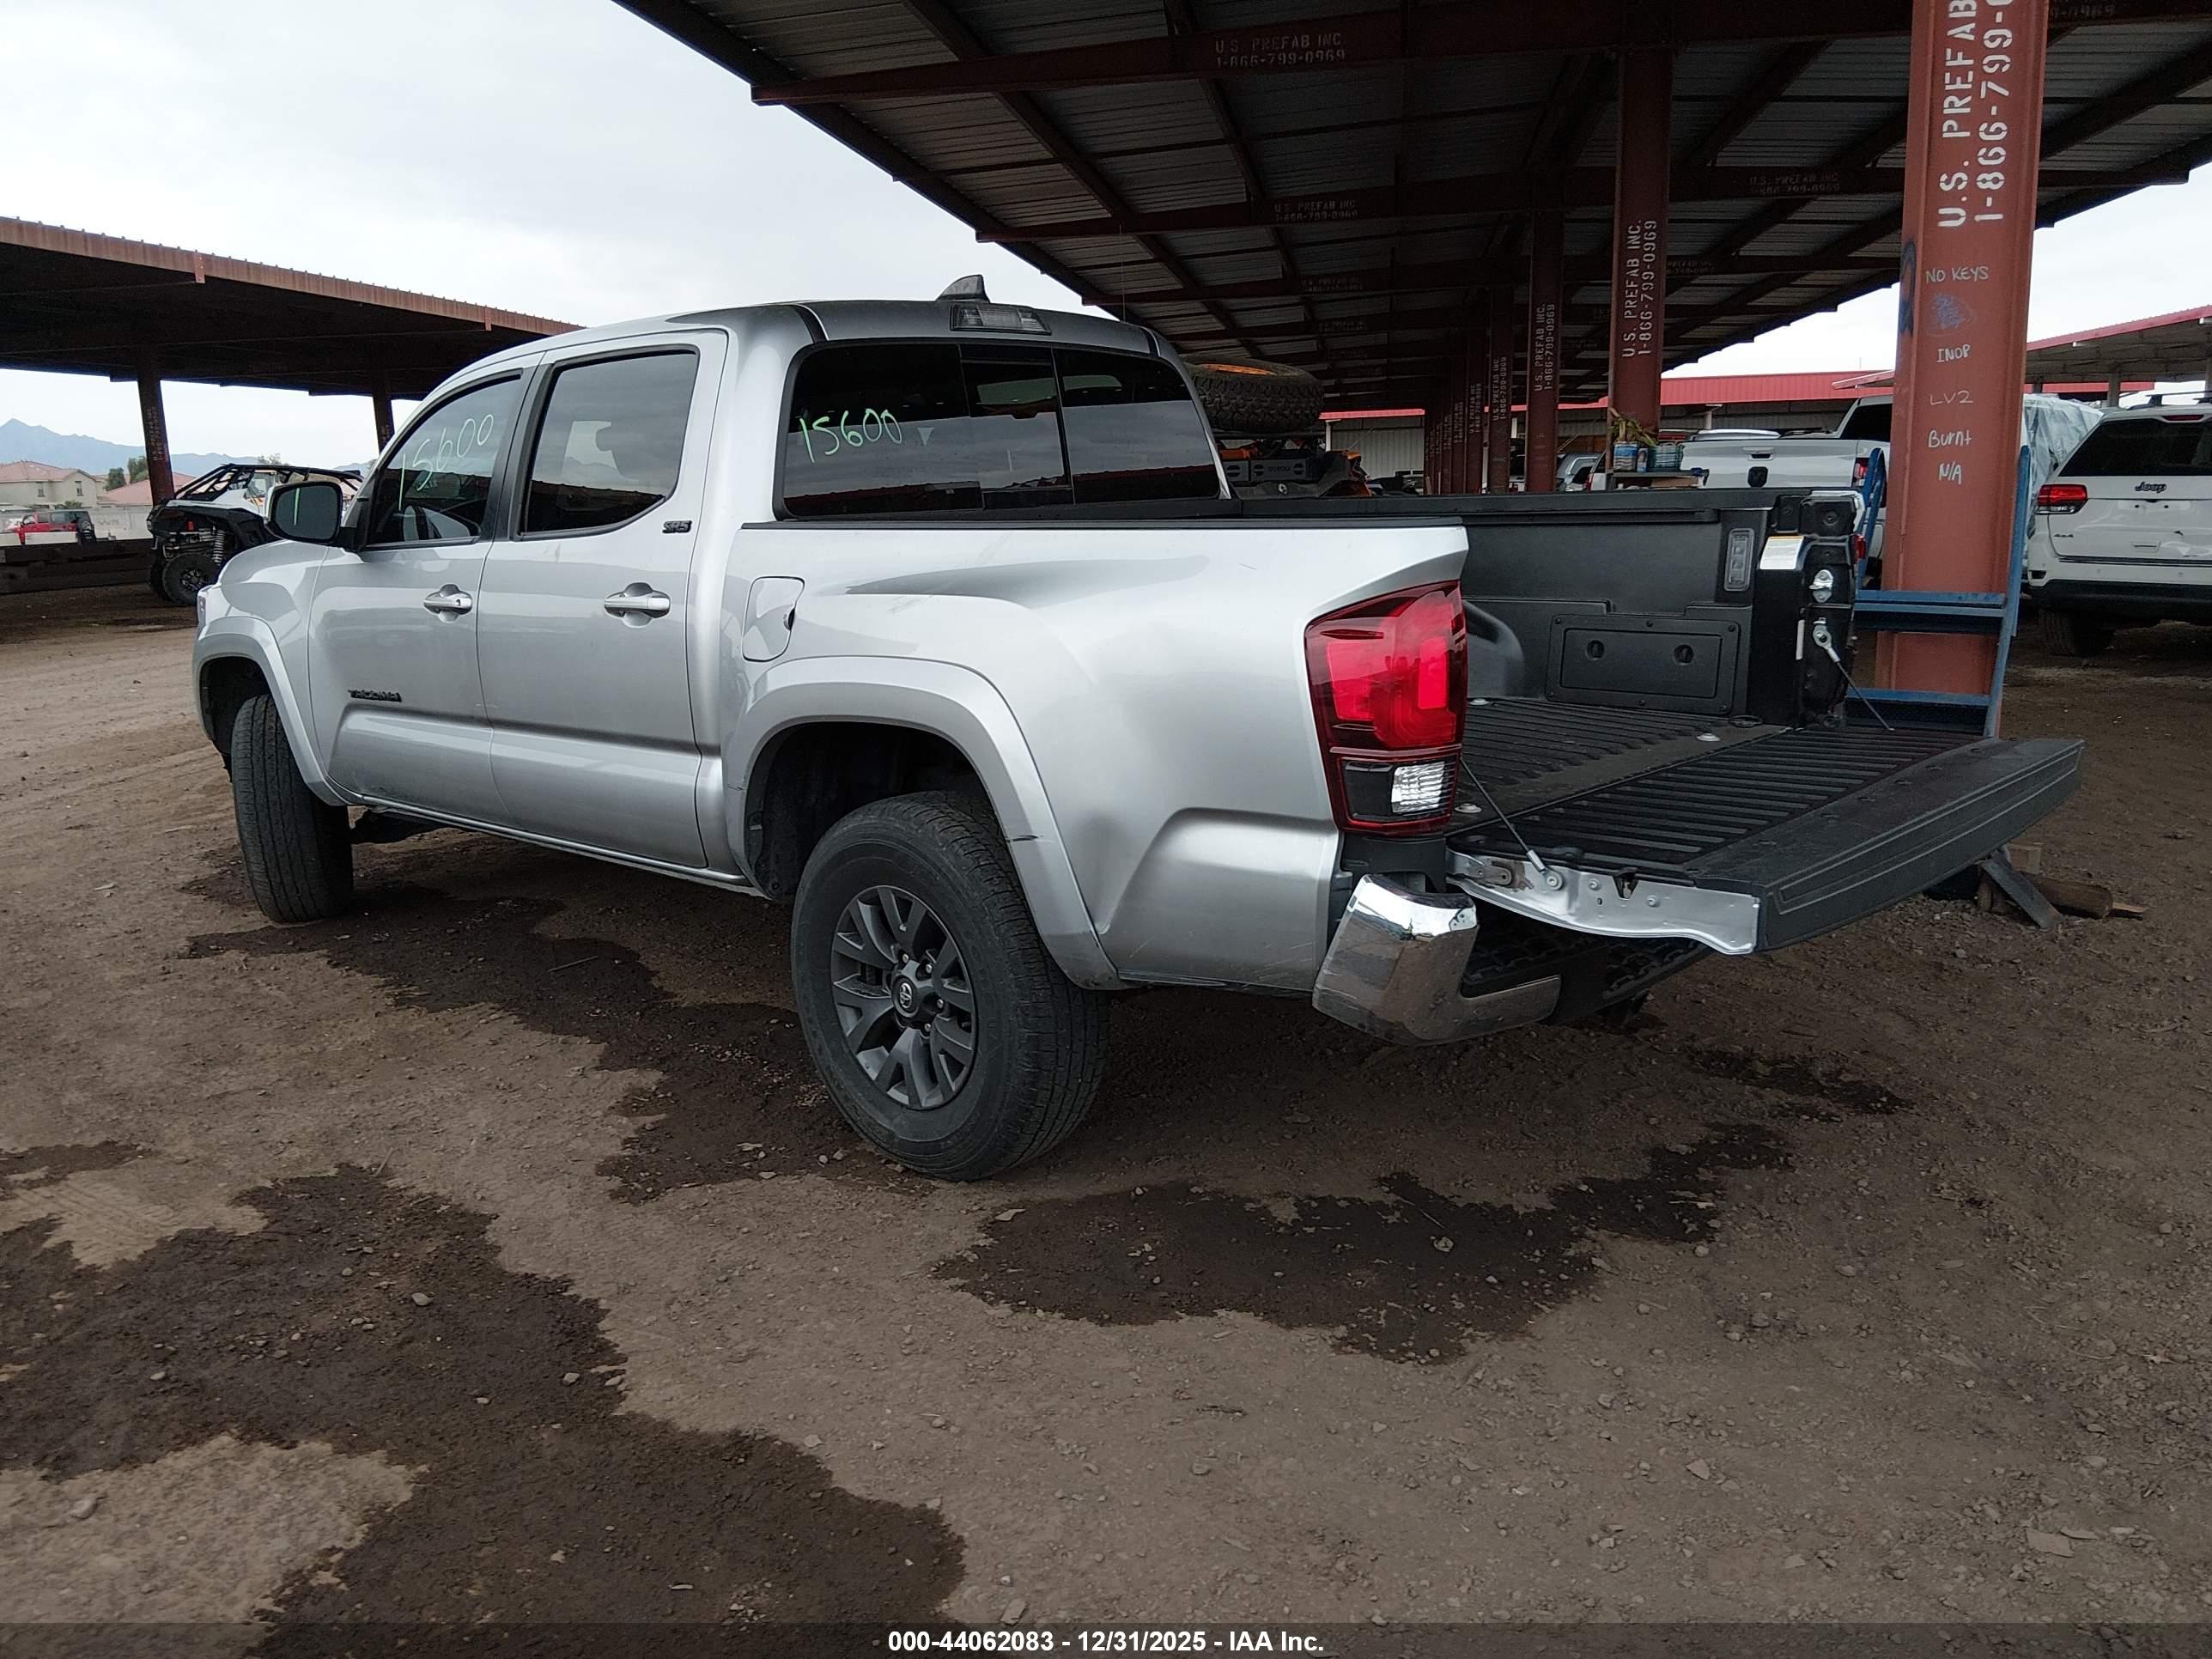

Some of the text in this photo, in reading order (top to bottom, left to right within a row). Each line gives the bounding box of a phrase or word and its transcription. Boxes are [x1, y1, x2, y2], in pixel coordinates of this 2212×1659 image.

[1251, 34, 1310, 52] PREFAB
[1937, 0, 1977, 228] U.S. PREFAB
[1925, 265, 1989, 284] NO KEYS
[1624, 258, 1640, 319] PREFAB
[1638, 220, 1657, 356] 1-866-799-0969
[1534, 327, 1545, 368] PREFAB
[1936, 343, 1971, 363] INOP
[1929, 390, 1974, 405] LV2
[799, 408, 903, 464] 15600
[1928, 429, 1972, 448] Burnt
[1938, 460, 1962, 484] N/A
[2135, 481, 2166, 494] Jeep
